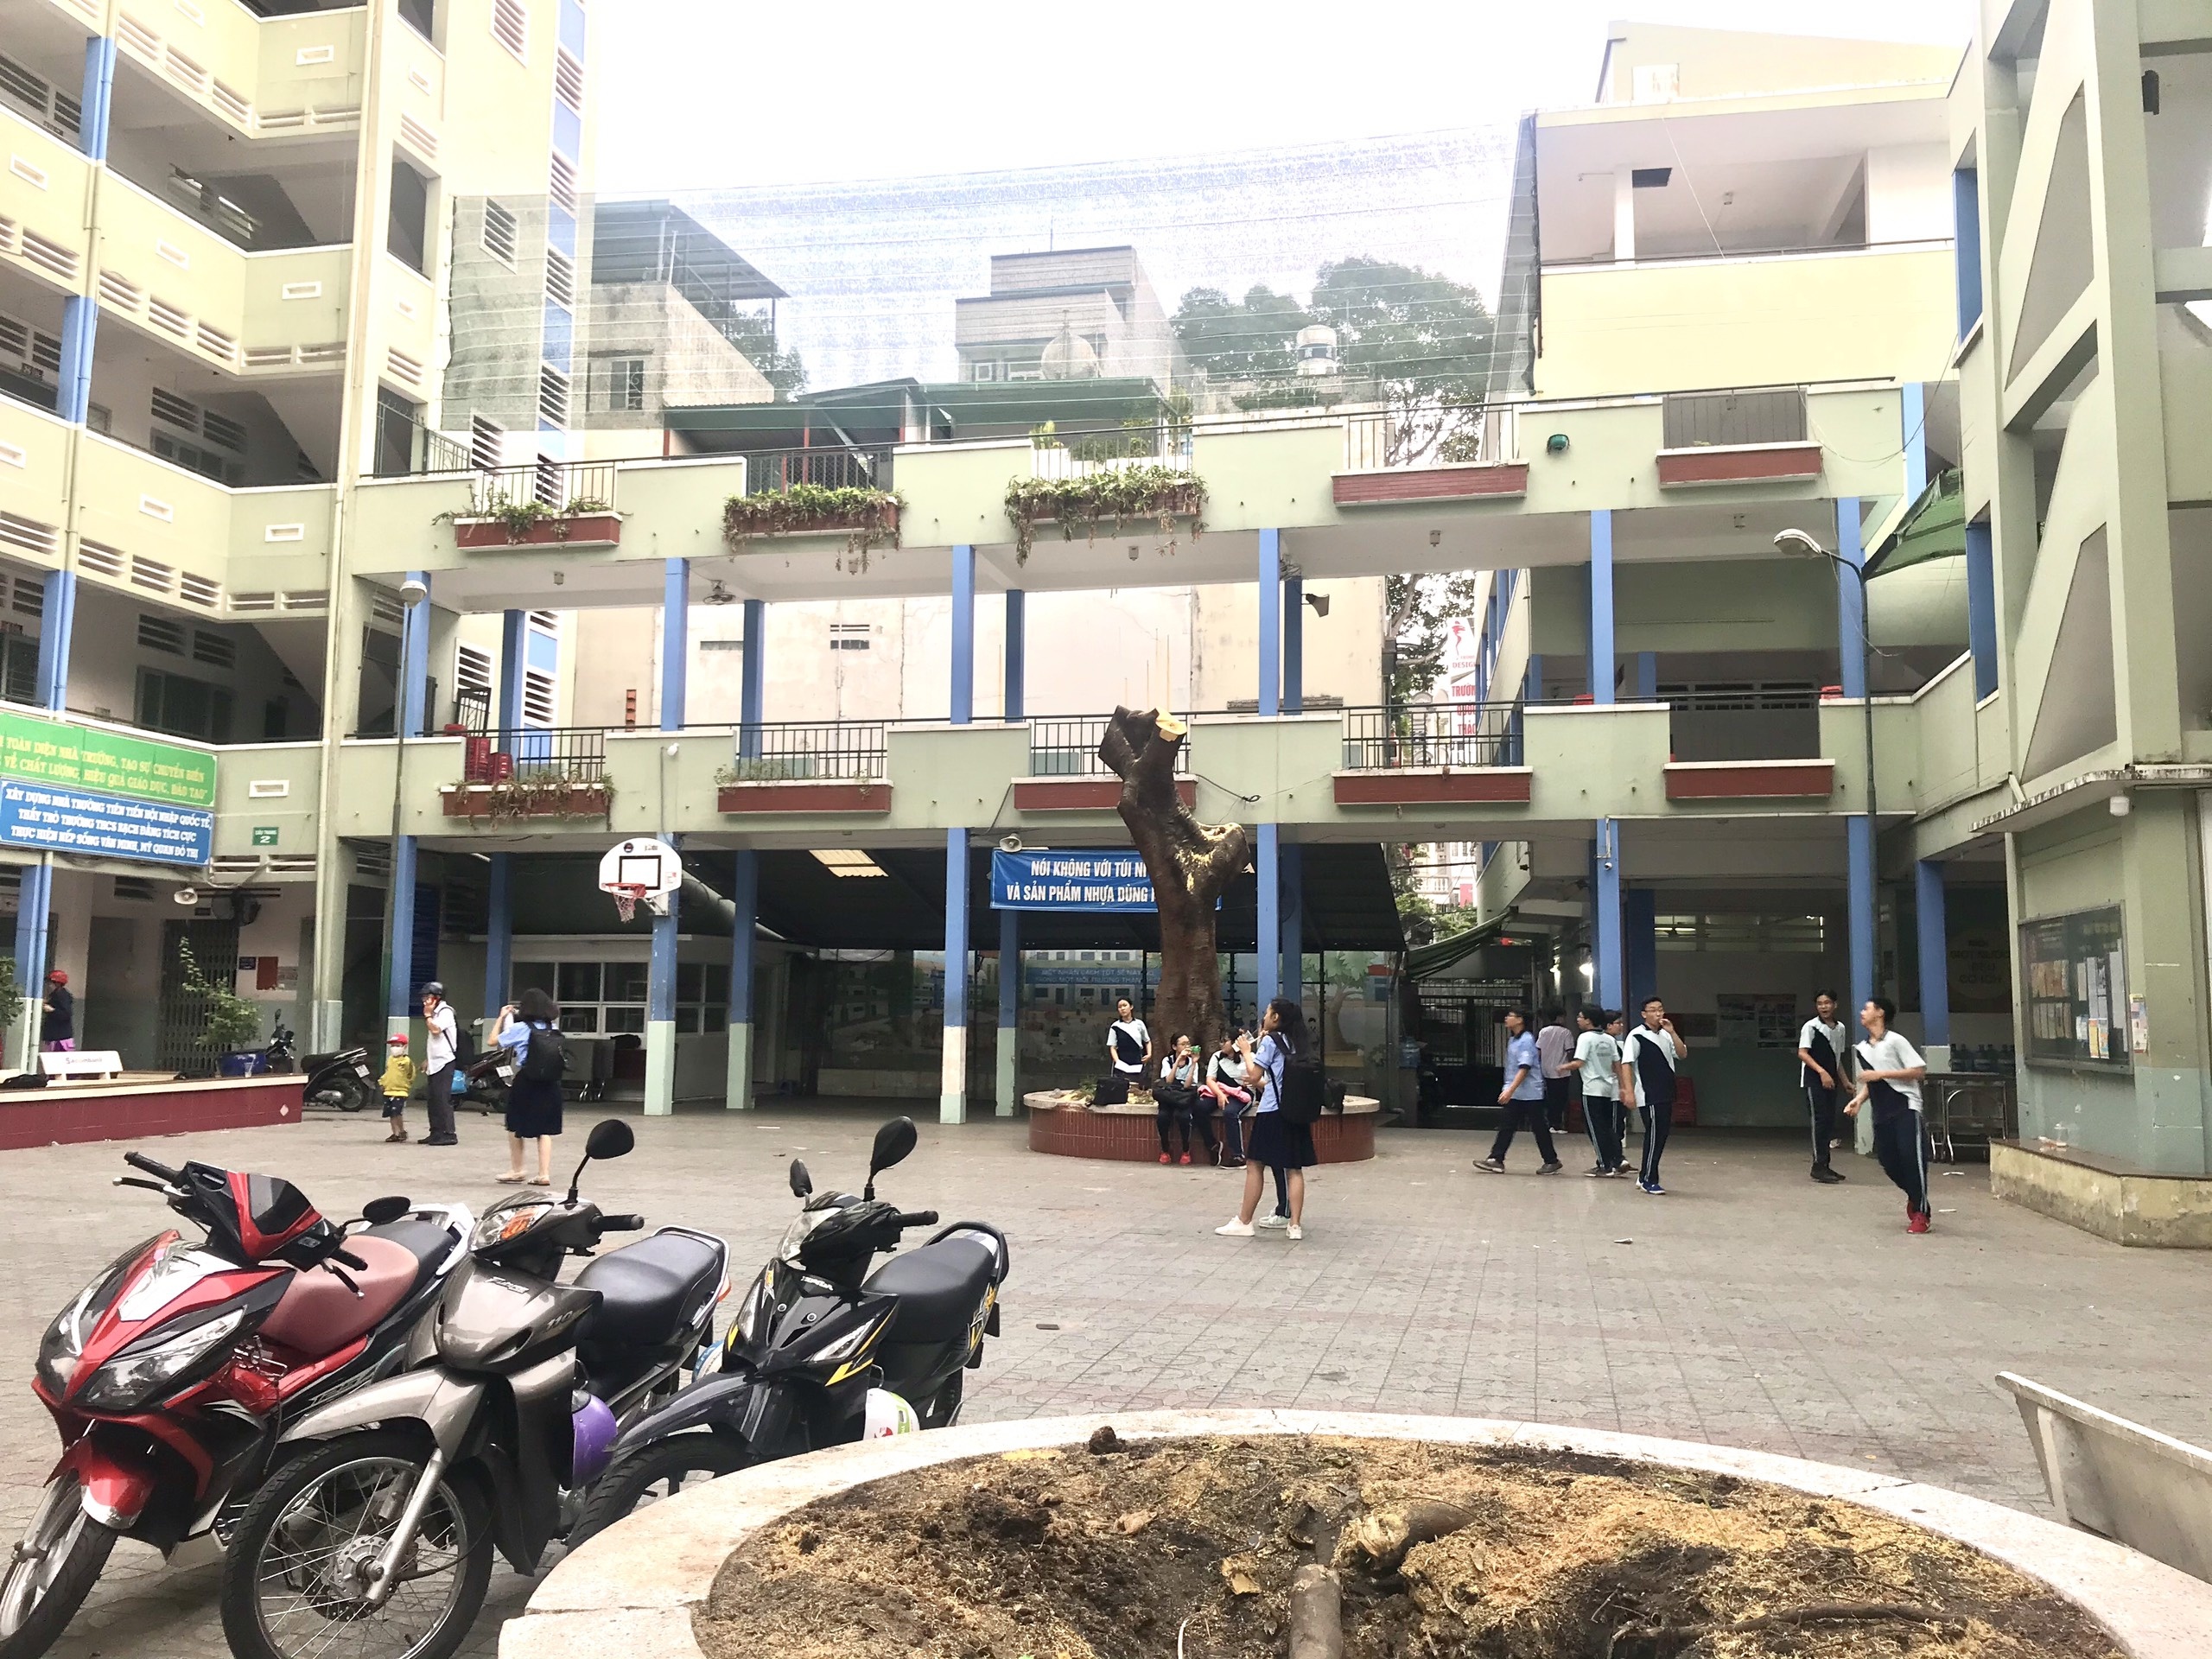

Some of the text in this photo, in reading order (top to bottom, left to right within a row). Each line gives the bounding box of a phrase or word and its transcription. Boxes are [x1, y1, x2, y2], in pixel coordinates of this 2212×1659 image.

[20, 756, 48, 773] CHẤT
[5, 786, 25, 801] XÂY
[25, 791, 52, 805] DỰNG
[52, 794, 71, 808] NHÀ
[71, 798, 105, 813] TRƯỜNG
[143, 808, 158, 822] HỘI
[159, 811, 179, 825] NHẬP
[180, 813, 201, 827] QUỐC
[42, 810, 60, 823] TRÒ
[60, 814, 95, 829] TRƯỜNG
[95, 818, 118, 831] THCS
[118, 822, 139, 835] BẠCH
[162, 827, 180, 840] TÍCH
[181, 831, 197, 843] CỰC
[11, 825, 36, 840] THỰC
[36, 827, 58, 842] HIỆN
[58, 829, 76, 843] NẾP
[76, 831, 100, 846] SỐNG
[153, 844, 175, 855] QUAN
[1031, 858, 1050, 876] NÓI
[1052, 859, 1090, 877] KHÔNG
[1094, 859, 1112, 878] VỚI
[1115, 858, 1132, 878] TÚI
[1007, 880, 1020, 900] VÀ
[1023, 880, 1046, 901] SẢN
[1049, 880, 1081, 901] PHẨM
[1084, 885, 1114, 905] NHỰA
[1117, 883, 1147, 902] DÙNG
[800, 1275, 834, 1291] HONDA
[546, 1310, 574, 1332] 110
